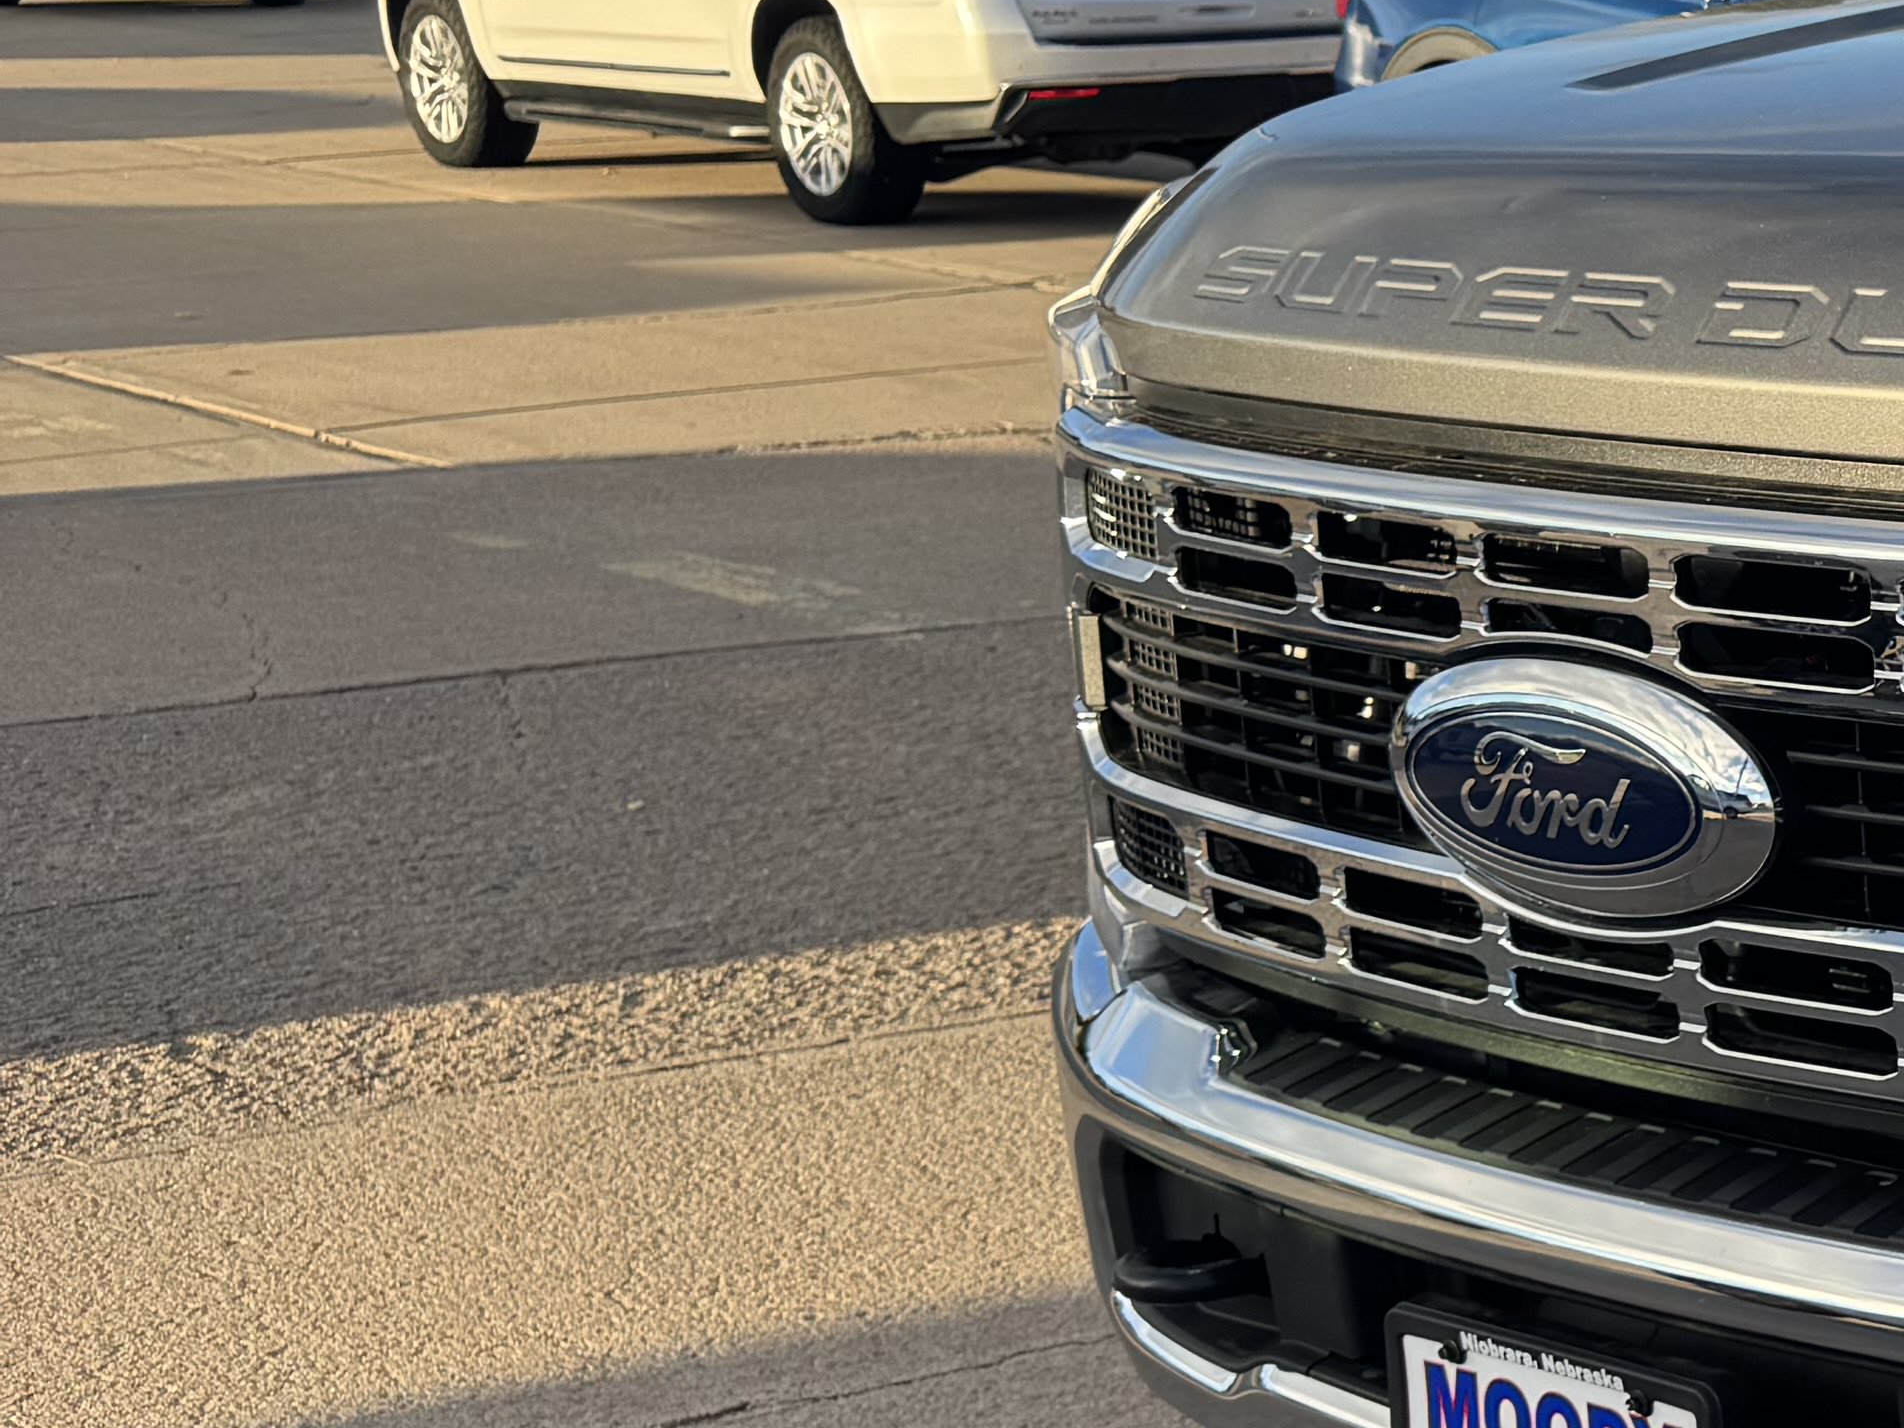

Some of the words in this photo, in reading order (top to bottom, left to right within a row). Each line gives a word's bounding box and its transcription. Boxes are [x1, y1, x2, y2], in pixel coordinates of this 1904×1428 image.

[1194, 245, 1676, 340] SUPER
[1458, 730, 1632, 850] Ford
[1459, 1330, 1539, 1371] Niobrara,
[1541, 1352, 1626, 1393] Nebraska
